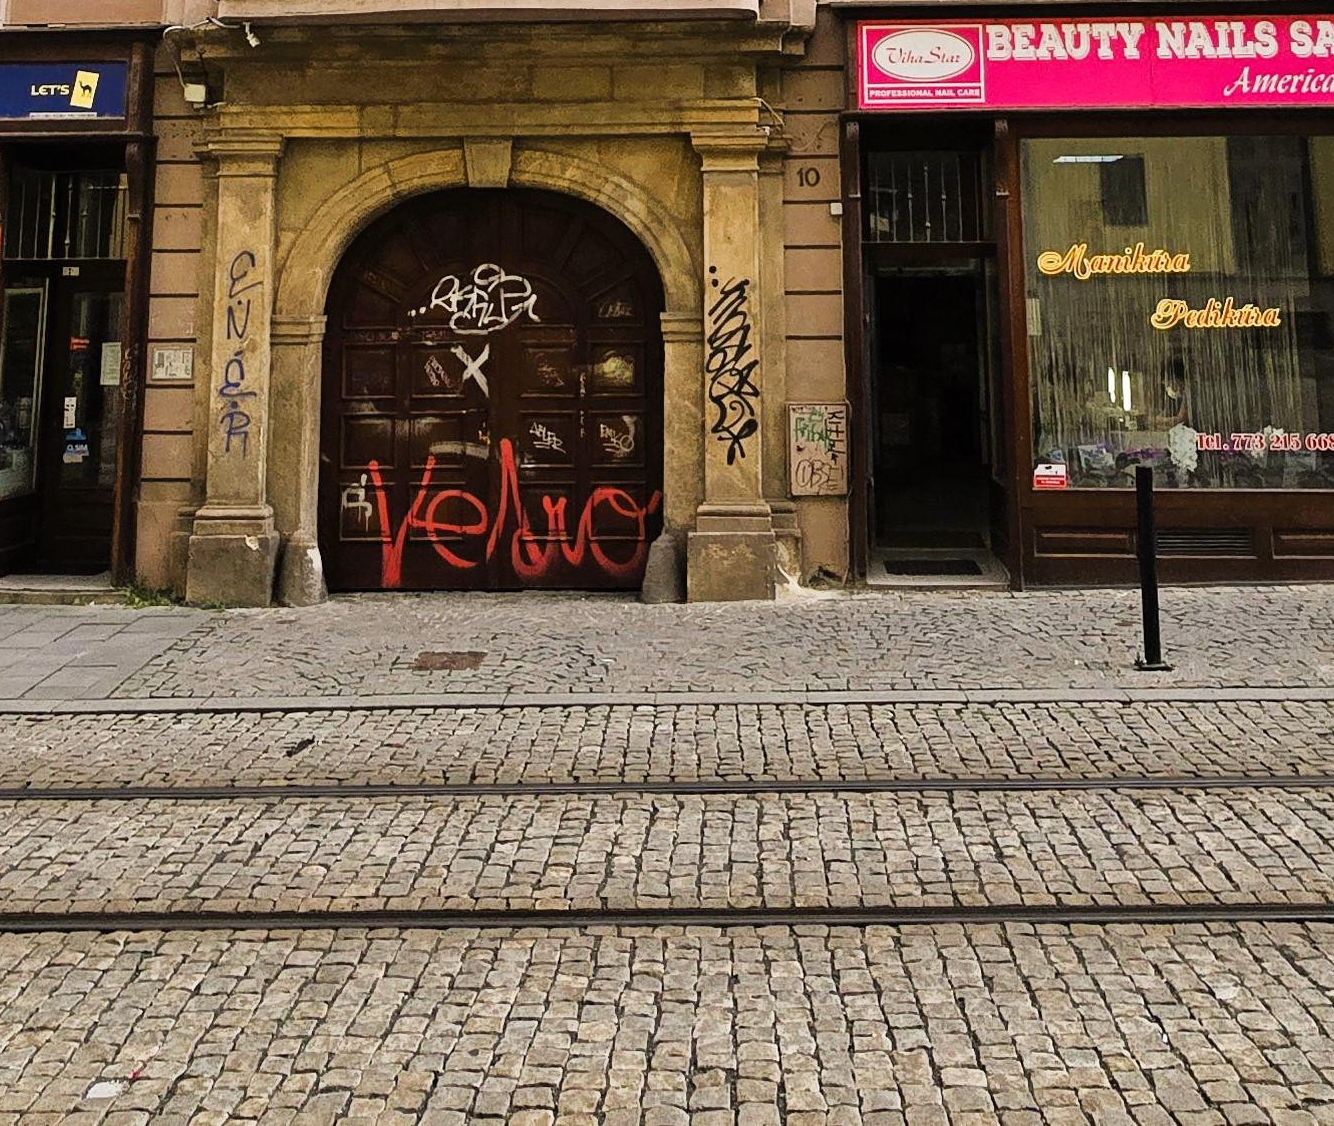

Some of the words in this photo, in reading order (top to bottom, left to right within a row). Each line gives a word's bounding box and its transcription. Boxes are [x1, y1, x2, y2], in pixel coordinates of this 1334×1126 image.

[986, 23, 1144, 62] BEAUTY
[1156, 21, 1277, 59] NAILS
[30, 85, 70, 96] LET'S
[869, 89, 933, 98] PROFESSIONAL
[935, 89, 955, 97] NAIL
[957, 88, 980, 97] CARE
[796, 167, 821, 187] 10
[1037, 242, 1191, 279] Manikúra
[1151, 297, 1282, 330] Pedikúra
[1196, 432, 1230, 451] Tel.
[1230, 432, 1265, 451] 773
[1269, 432, 1301, 451] 215
